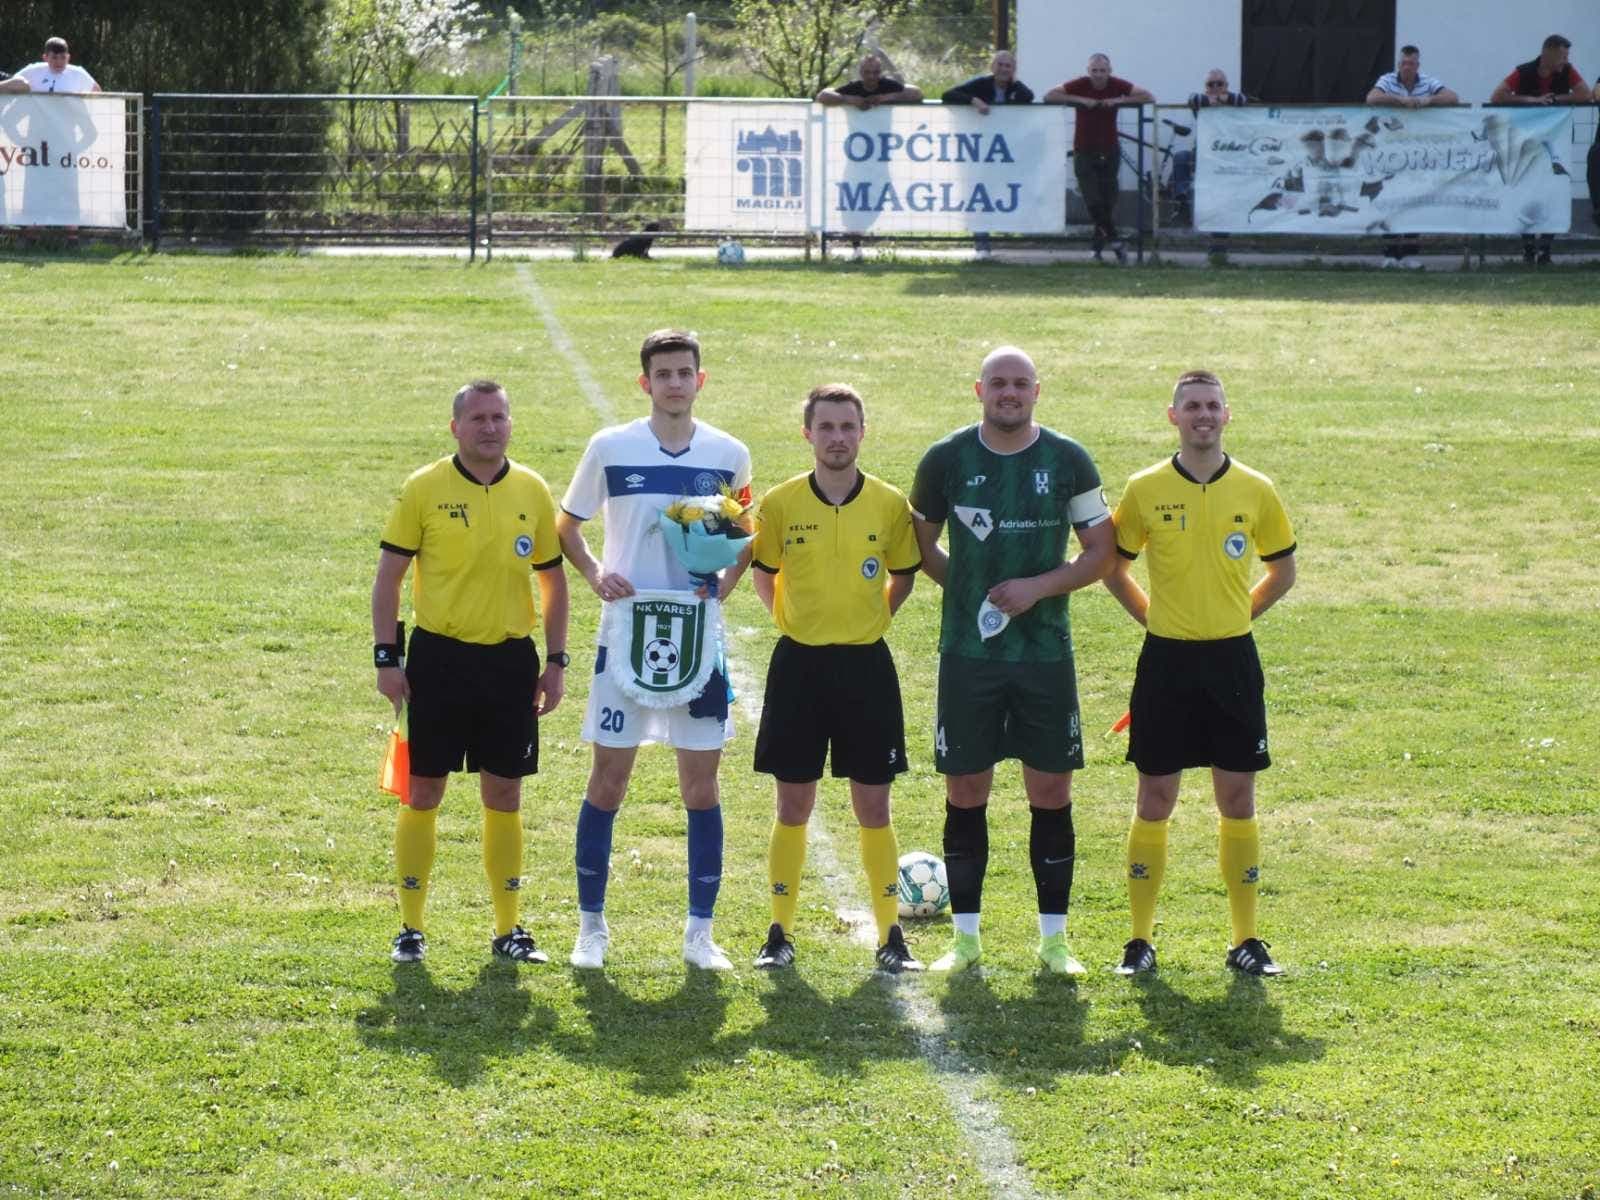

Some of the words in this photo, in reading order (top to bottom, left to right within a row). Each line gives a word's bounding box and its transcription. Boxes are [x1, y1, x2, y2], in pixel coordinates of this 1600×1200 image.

[843, 124, 1015, 163] OPĆINA
[60, 152, 113, 168] d.o.o.
[835, 182, 1022, 213] MAGLAJ
[1155, 503, 1185, 511] KELME
[999, 519, 1037, 529] Adriatic
[636, 604, 652, 612] NK
[600, 706, 625, 733] 20
